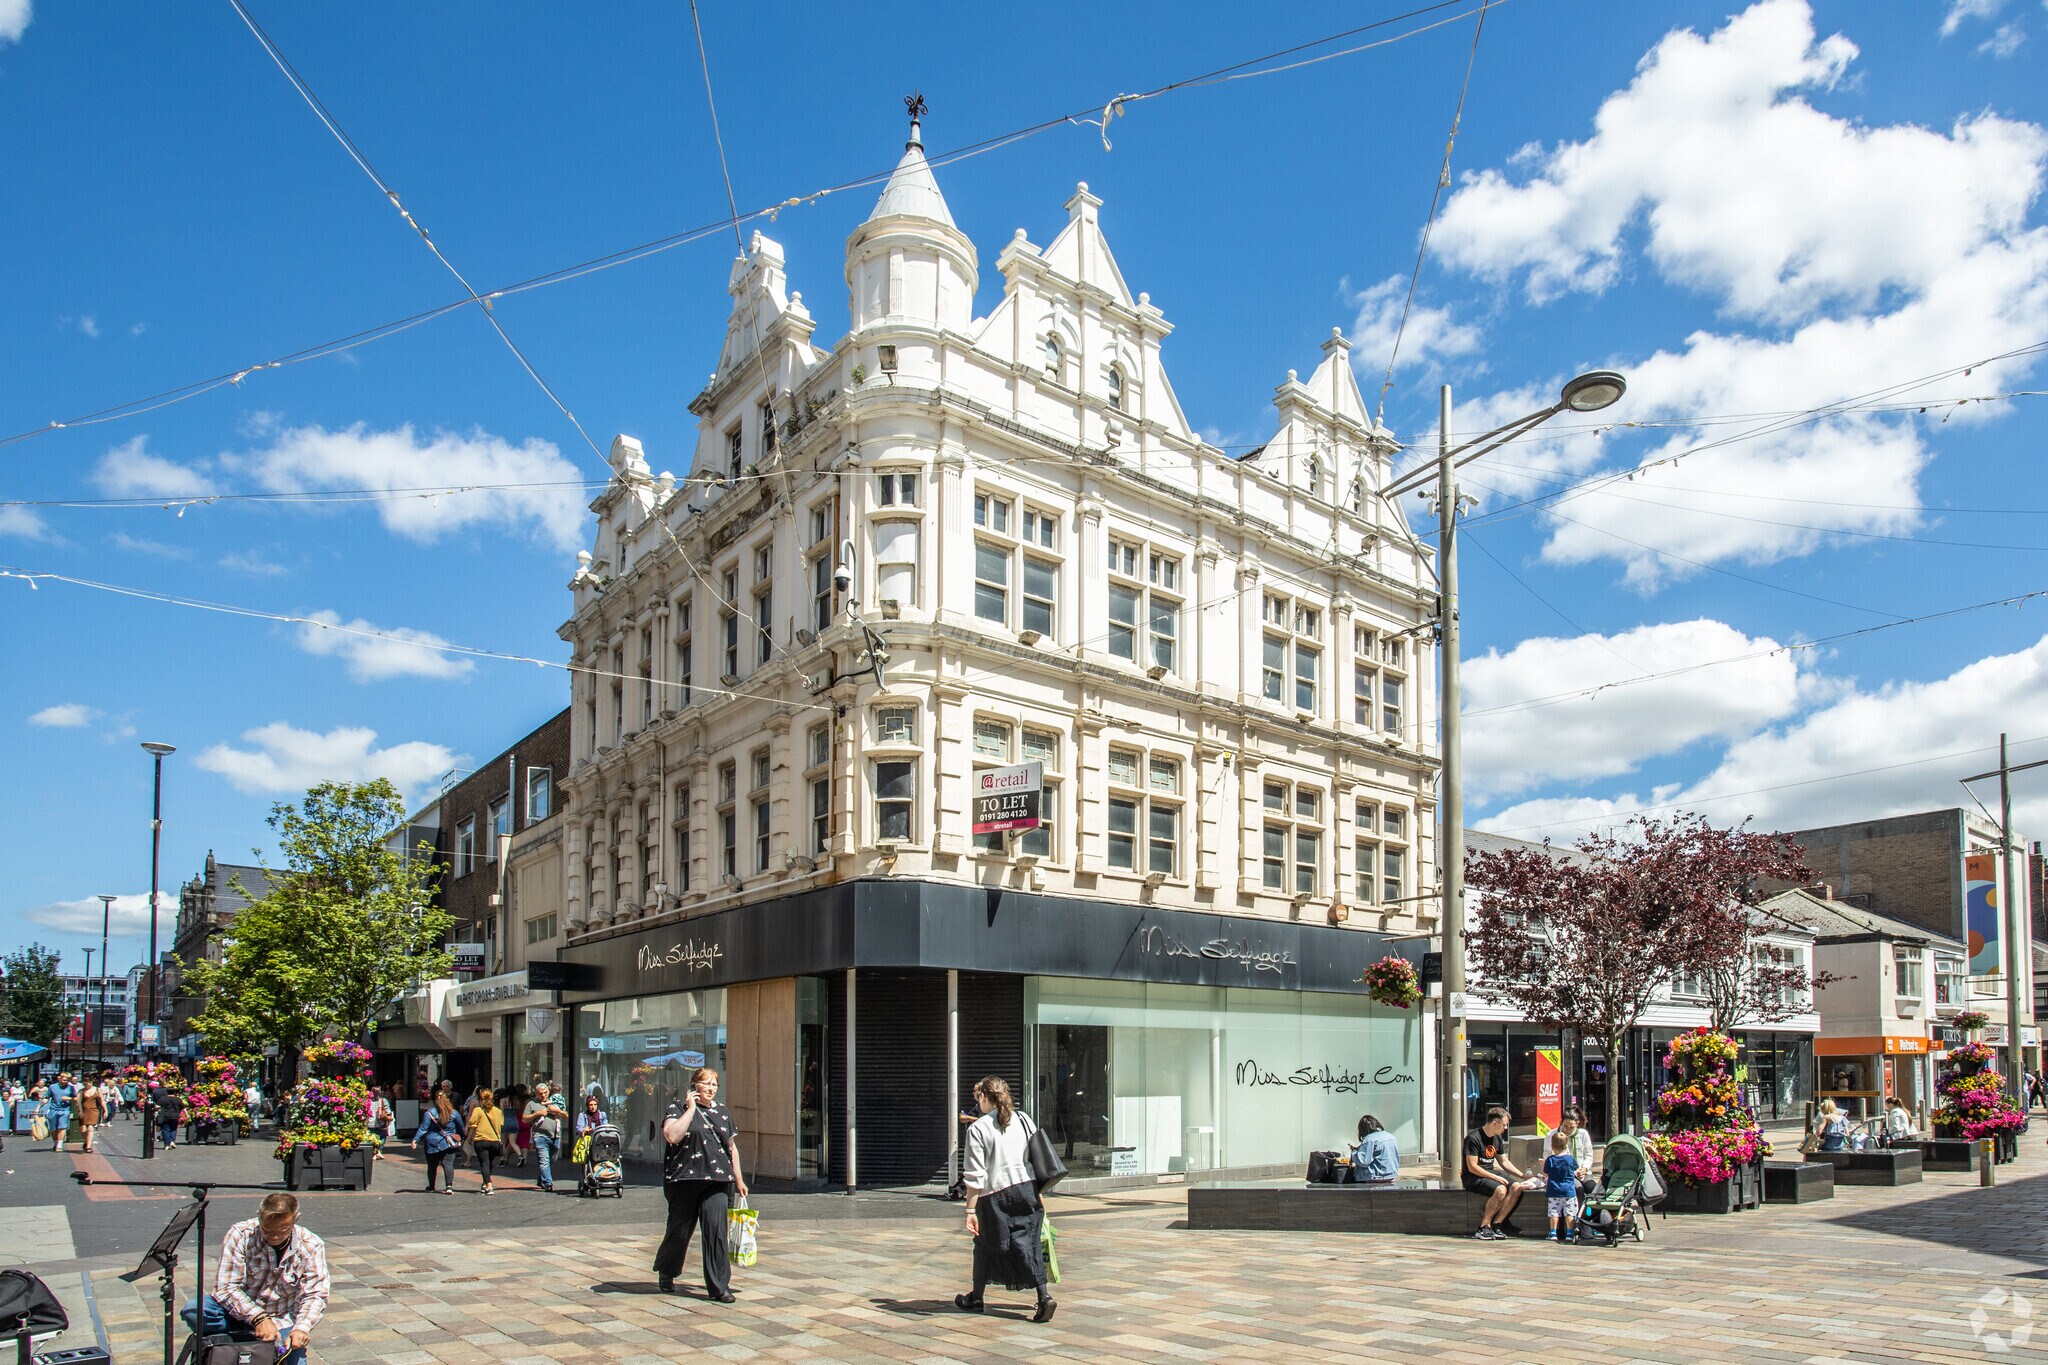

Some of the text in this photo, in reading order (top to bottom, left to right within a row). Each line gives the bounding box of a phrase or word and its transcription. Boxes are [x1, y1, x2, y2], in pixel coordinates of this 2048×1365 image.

[980, 794, 1028, 812] TO LET
[980, 809, 1028, 822] 0191 280 4120
[638, 937, 723, 973] Miss Selfridge
[1140, 925, 1297, 975] Miss Selfridge
[1236, 1059, 1287, 1087] Miss
[1540, 1083, 1559, 1097] SALE
